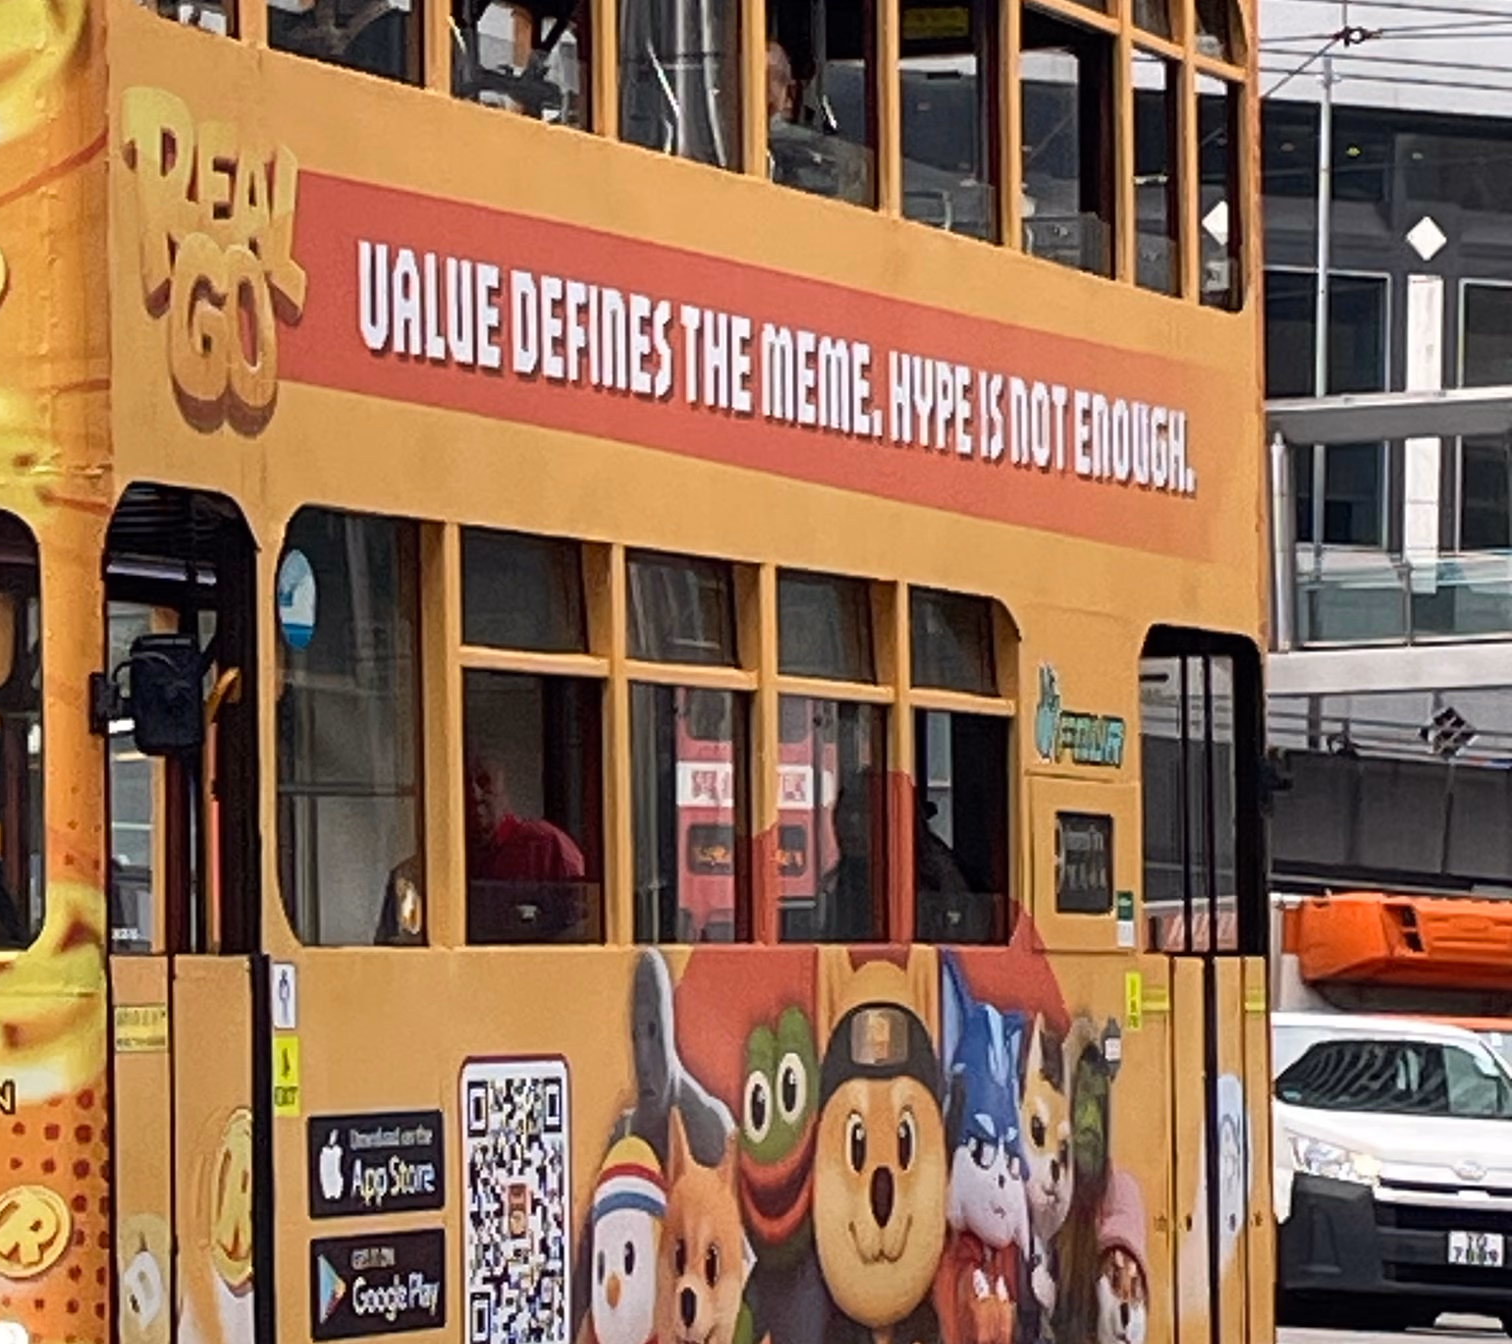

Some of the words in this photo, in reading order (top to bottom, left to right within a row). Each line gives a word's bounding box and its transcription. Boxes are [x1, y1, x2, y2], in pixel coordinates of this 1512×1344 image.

[122, 86, 307, 324] REAL
[169, 230, 278, 436] GO
[357, 239, 502, 370] VALUE
[510, 269, 674, 400] DEFINES
[681, 303, 753, 413] THE
[761, 322, 884, 438] MEME.
[888, 349, 972, 455] HYPE
[978, 369, 1005, 459] IS
[1010, 376, 1069, 470] NOT
[1073, 389, 1197, 494] ENOUGH.
[350, 1158, 388, 1207] App
[389, 1154, 436, 1196] Store
[352, 1273, 408, 1322] Google
[408, 1271, 440, 1317] Play
